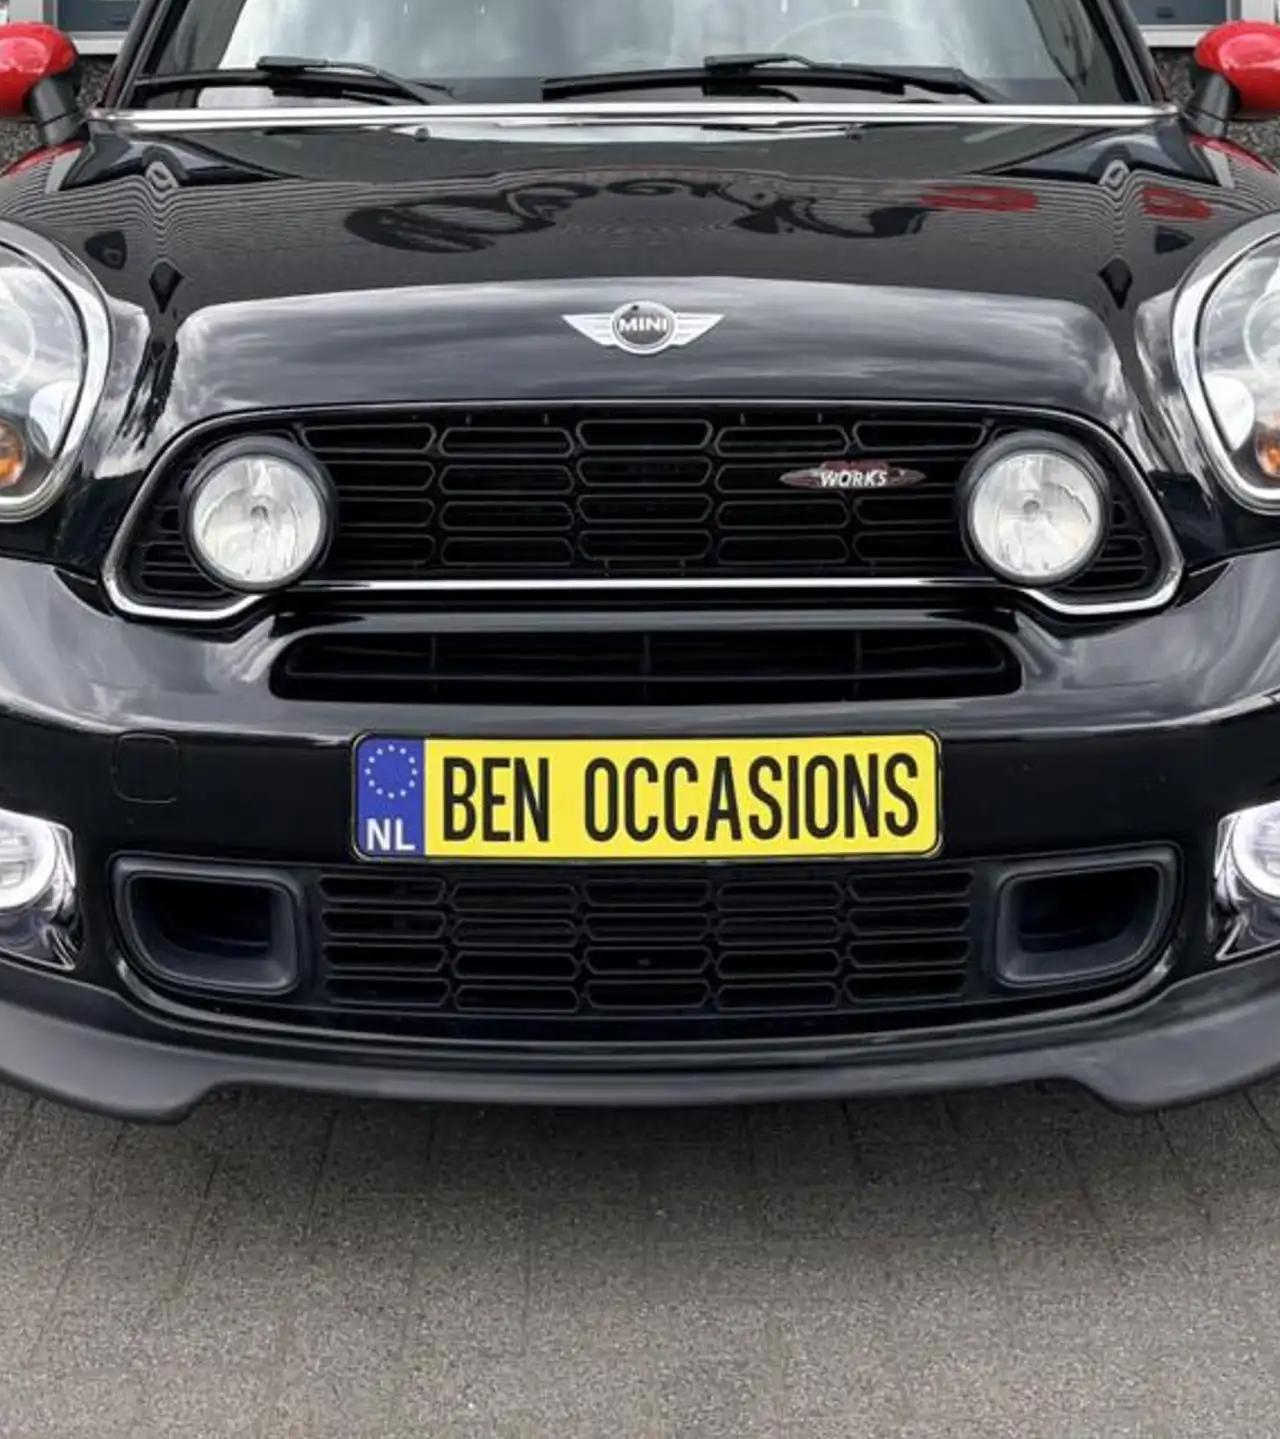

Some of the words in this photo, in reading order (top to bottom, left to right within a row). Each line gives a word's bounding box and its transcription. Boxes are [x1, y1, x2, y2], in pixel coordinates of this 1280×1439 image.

[619, 317, 668, 332] MINI
[821, 469, 888, 488] WORKS
[442, 756, 550, 843] BEN
[584, 753, 919, 842] OCCASIONS
[366, 819, 416, 851] NL
